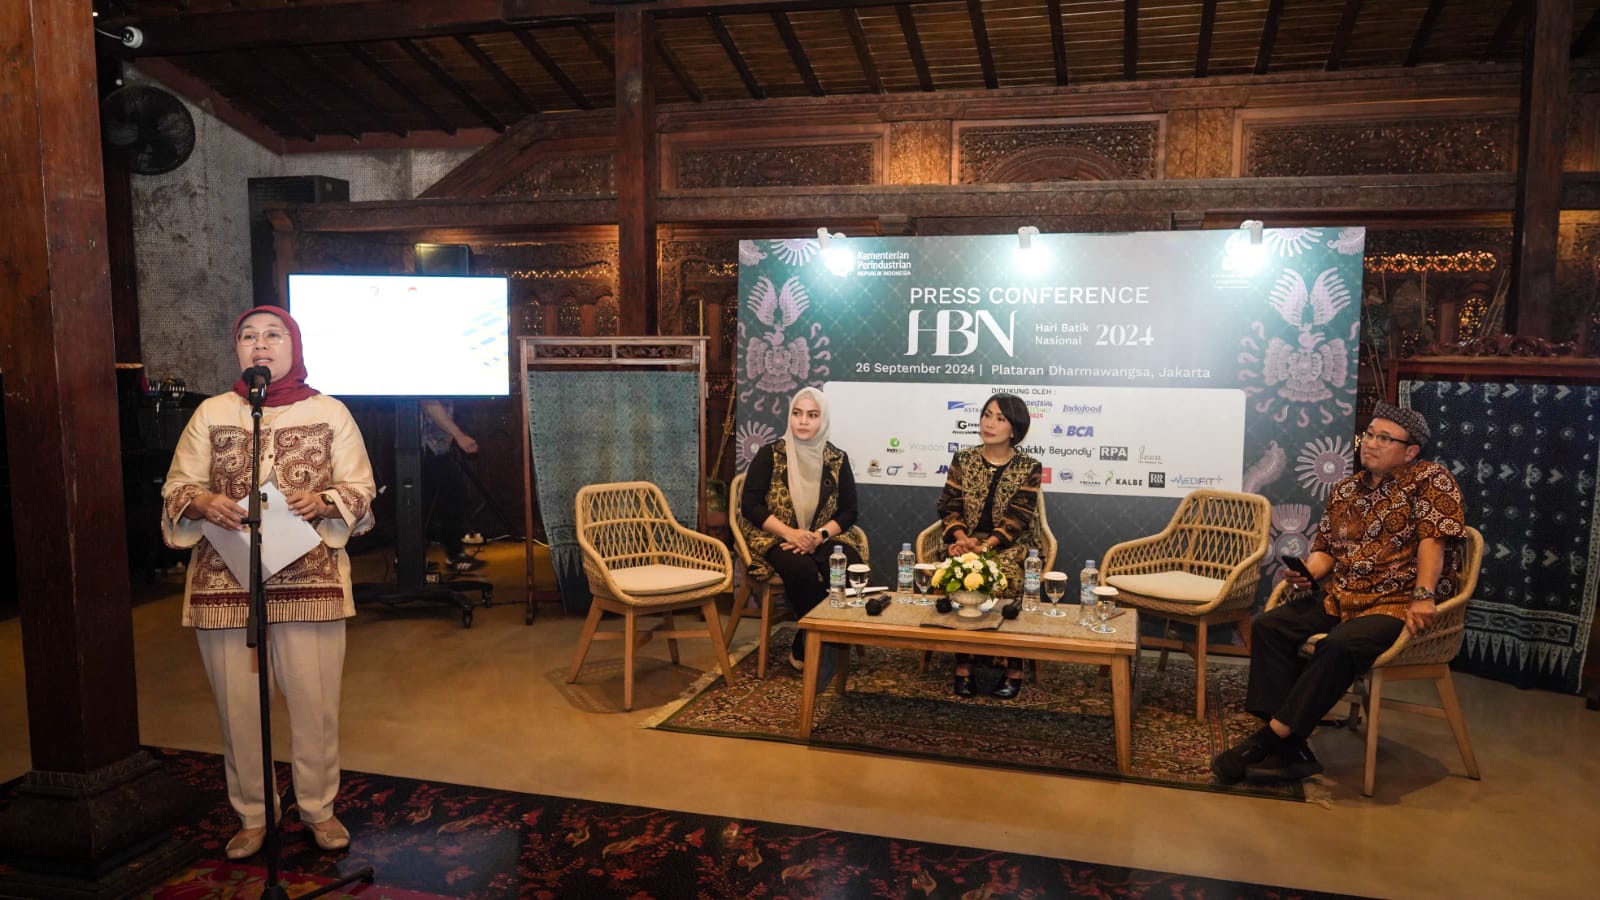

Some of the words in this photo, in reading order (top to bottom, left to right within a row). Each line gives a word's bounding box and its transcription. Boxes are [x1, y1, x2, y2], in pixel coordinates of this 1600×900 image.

[857, 250, 910, 260] Kementerian
[857, 260, 912, 270] Perindustrian
[910, 287, 981, 305] PRESS
[989, 286, 1151, 305] CONFERENCE
[1035, 323, 1058, 333] Hari
[1061, 322, 1090, 333] Batik
[903, 309, 1019, 358] HBN
[1095, 323, 1155, 347] 2024
[1035, 335, 1083, 346] Nasional
[855, 362, 870, 373] 26
[874, 363, 941, 376] September
[945, 364, 976, 375] 2024
[991, 364, 1044, 376] Plataran
[1049, 365, 1155, 380] Dharmawangsa,
[1159, 366, 1211, 379] Jakarta
[991, 387, 1030, 395] DIDUKUNG
[1062, 404, 1102, 415] Indofood
[1066, 426, 1094, 438] BCA
[1015, 445, 1046, 456] Quickly
[1100, 447, 1127, 457] RPA
